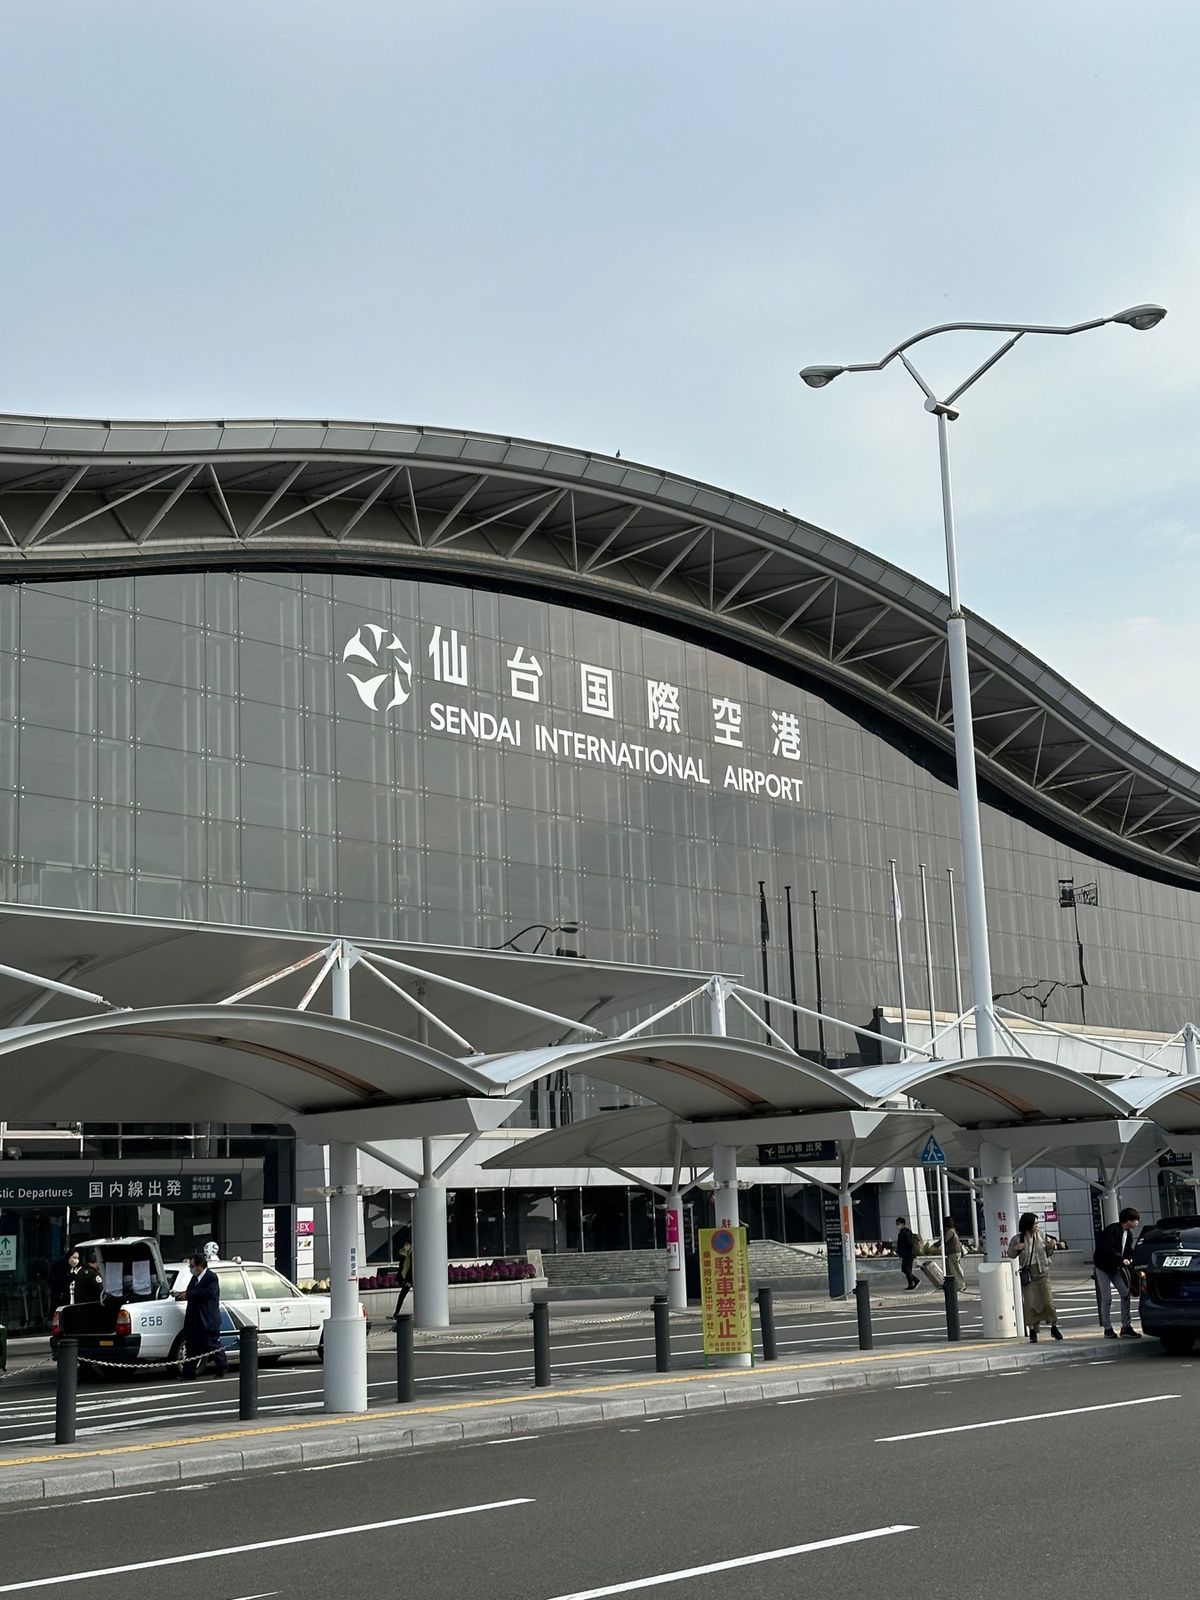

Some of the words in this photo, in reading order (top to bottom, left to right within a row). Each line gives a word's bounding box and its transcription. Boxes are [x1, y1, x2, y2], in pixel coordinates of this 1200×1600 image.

[428, 625, 802, 761] 仙台国際空港
[430, 702, 521, 746] SENDAI
[535, 724, 710, 785] INTERNATIONAL
[723, 765, 803, 802] AIRPORT
[18, 1187, 73, 1200] Departures
[89, 1179, 181, 1199] 国内線出発
[224, 1178, 233, 1195] 2
[715, 1256, 738, 1339] 駐車禁止
[141, 1316, 163, 1327] 256
